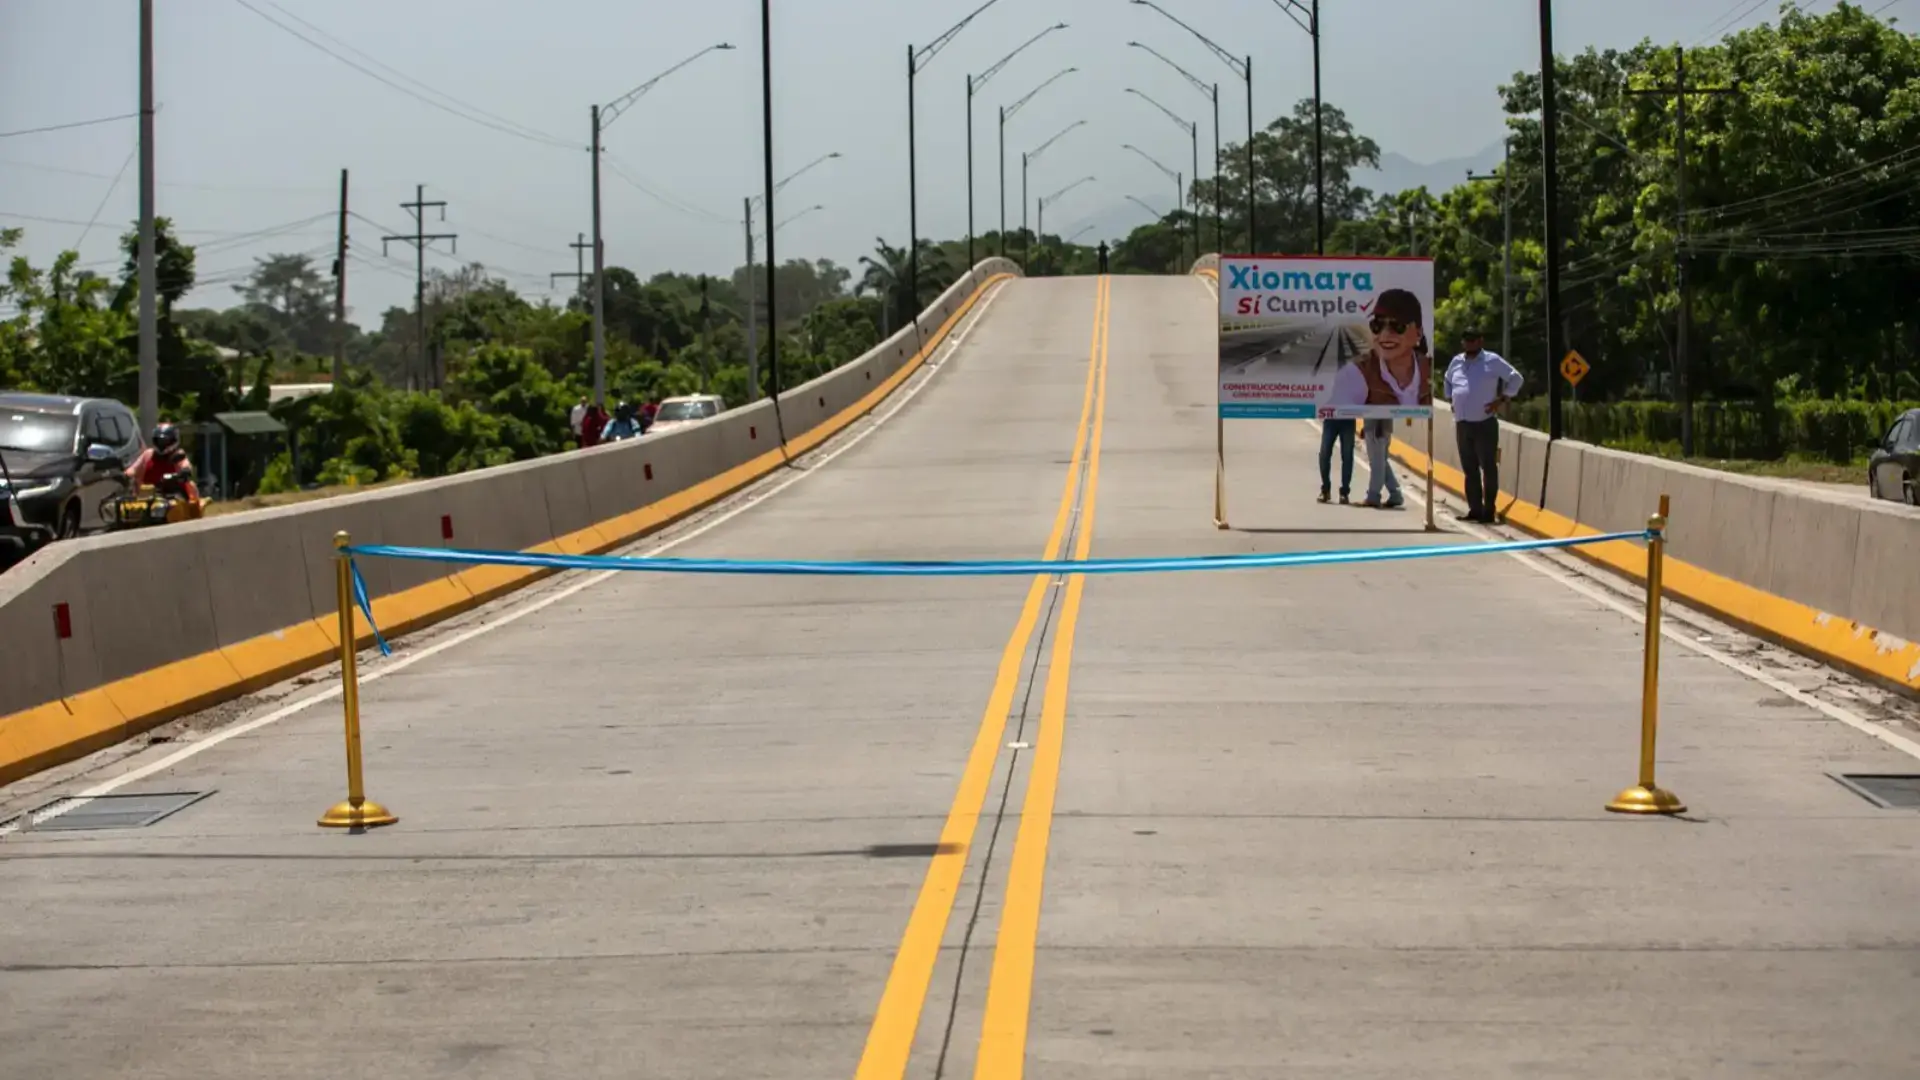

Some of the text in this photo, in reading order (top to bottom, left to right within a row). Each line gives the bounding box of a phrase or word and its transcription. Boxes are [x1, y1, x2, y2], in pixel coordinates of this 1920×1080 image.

[1228, 264, 1373, 291] Xiomara
[1237, 295, 1357, 317] Sí Cumple
[1223, 382, 1289, 391] CONSTRUCCIÓN
